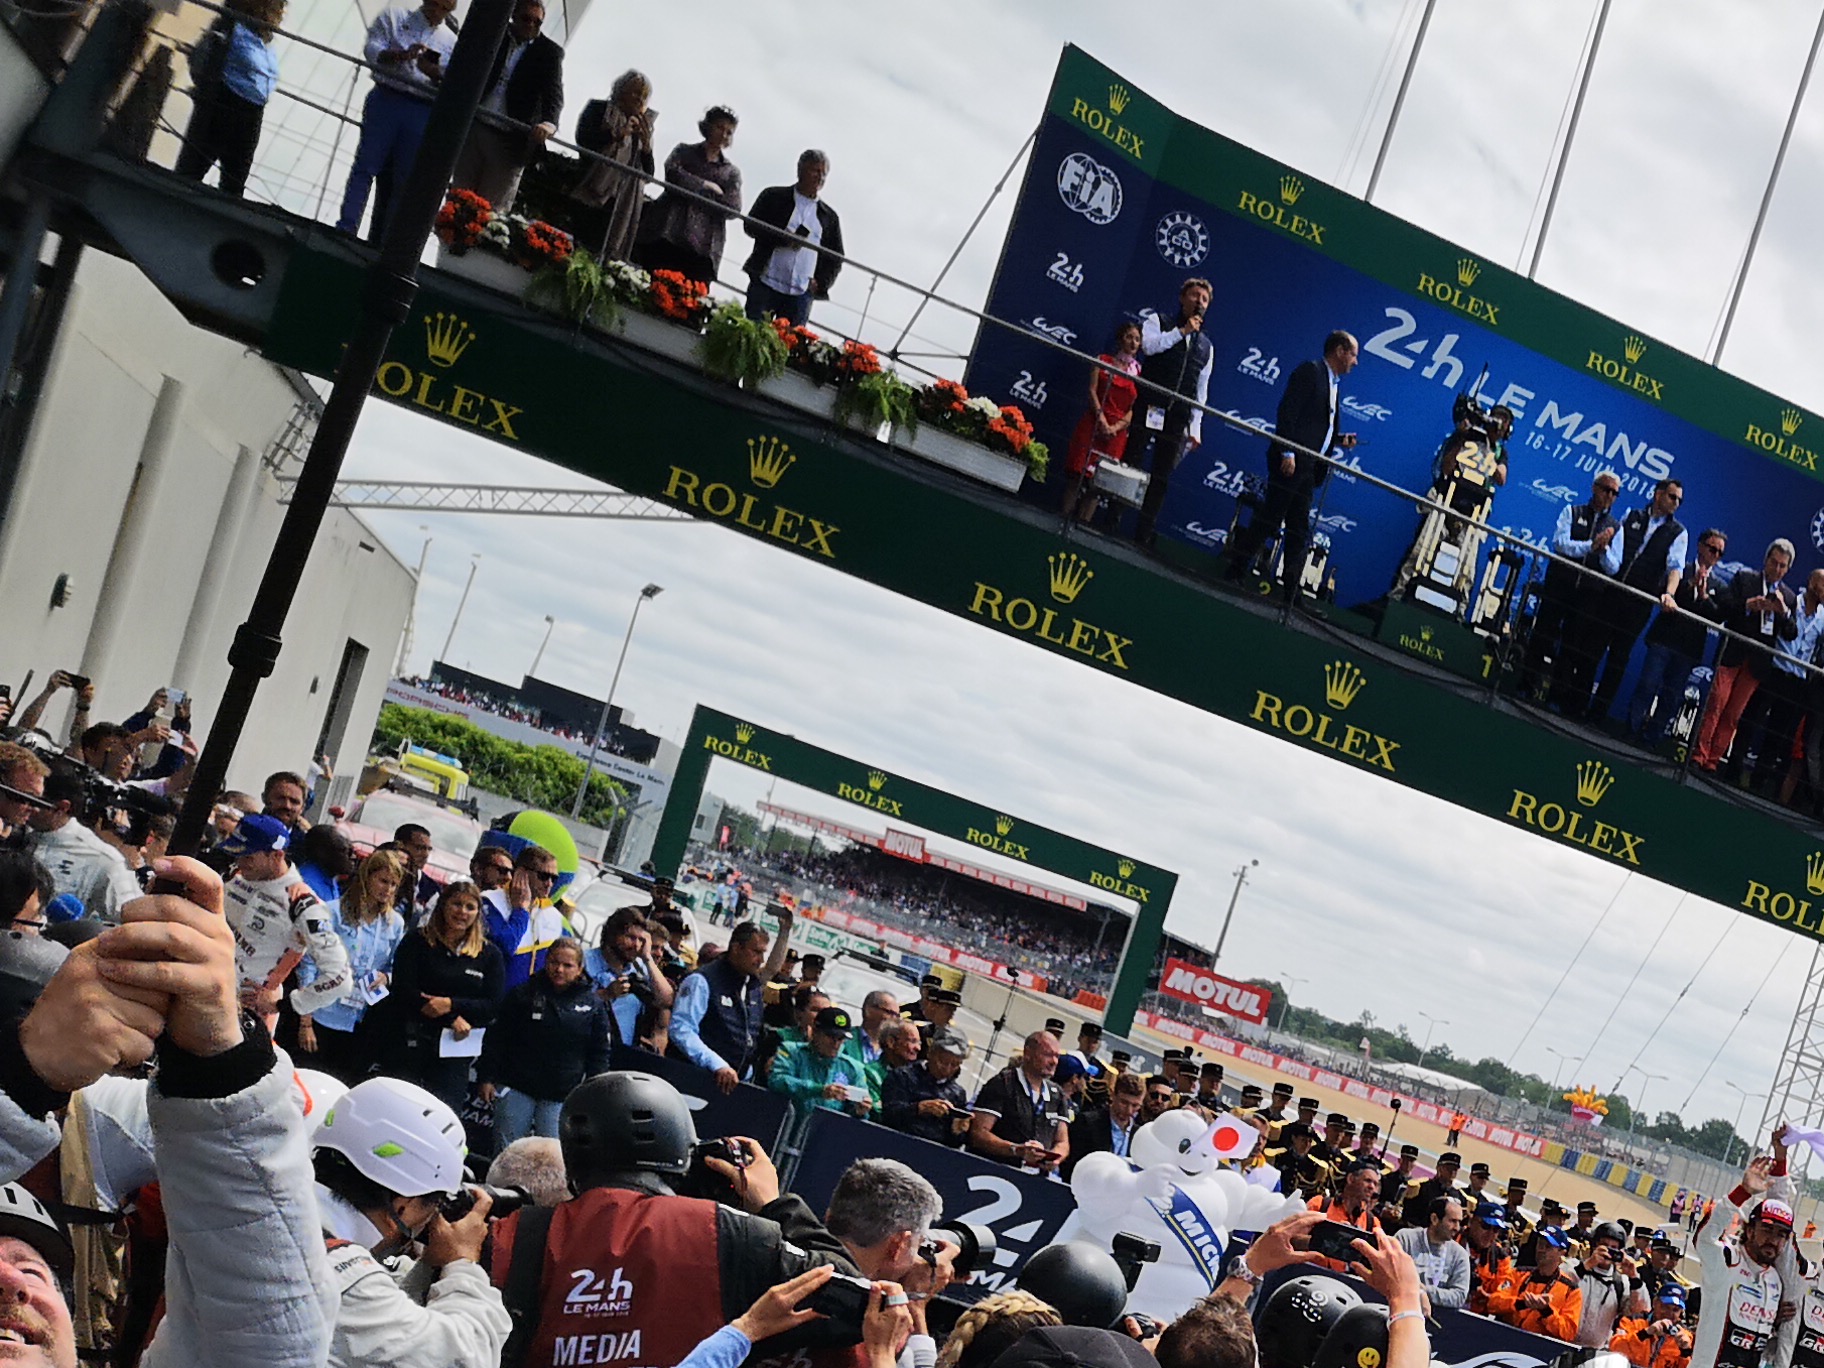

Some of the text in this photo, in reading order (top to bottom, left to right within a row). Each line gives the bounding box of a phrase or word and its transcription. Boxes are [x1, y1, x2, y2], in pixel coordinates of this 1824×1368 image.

[1070, 97, 1146, 160] ROLEX
[1238, 191, 1327, 247] ROLEX
[1049, 252, 1085, 287] 24h
[1416, 273, 1500, 326] ROLEX
[1239, 348, 1282, 379] 24h
[1585, 350, 1666, 400] ROLEX
[337, 343, 524, 440] OLEX
[1012, 370, 1048, 404] 24h
[1364, 307, 1465, 388] 24h
[1535, 400, 1676, 481] MANS
[1744, 424, 1818, 471] ROLEX
[662, 465, 841, 560] ROLEX
[968, 582, 1133, 670] ROLEX
[1400, 634, 1445, 661] ROLEX
[1482, 655, 1493, 677] 1
[1249, 690, 1401, 772] ROLEX
[704, 734, 771, 772] ROLEX
[837, 781, 903, 818] ROLEX
[966, 826, 1029, 863] ROLEX
[1507, 790, 1645, 866] ROLEX
[1089, 869, 1150, 904] ROLEX
[1166, 968, 1261, 1017] MOTUL
[566, 1267, 633, 1303] 24h
[968, 1270, 1017, 1292] MA
[563, 1300, 630, 1314] LE MANS
[1739, 1301, 1777, 1320] DENS
[553, 1329, 642, 1367] MEDIA
